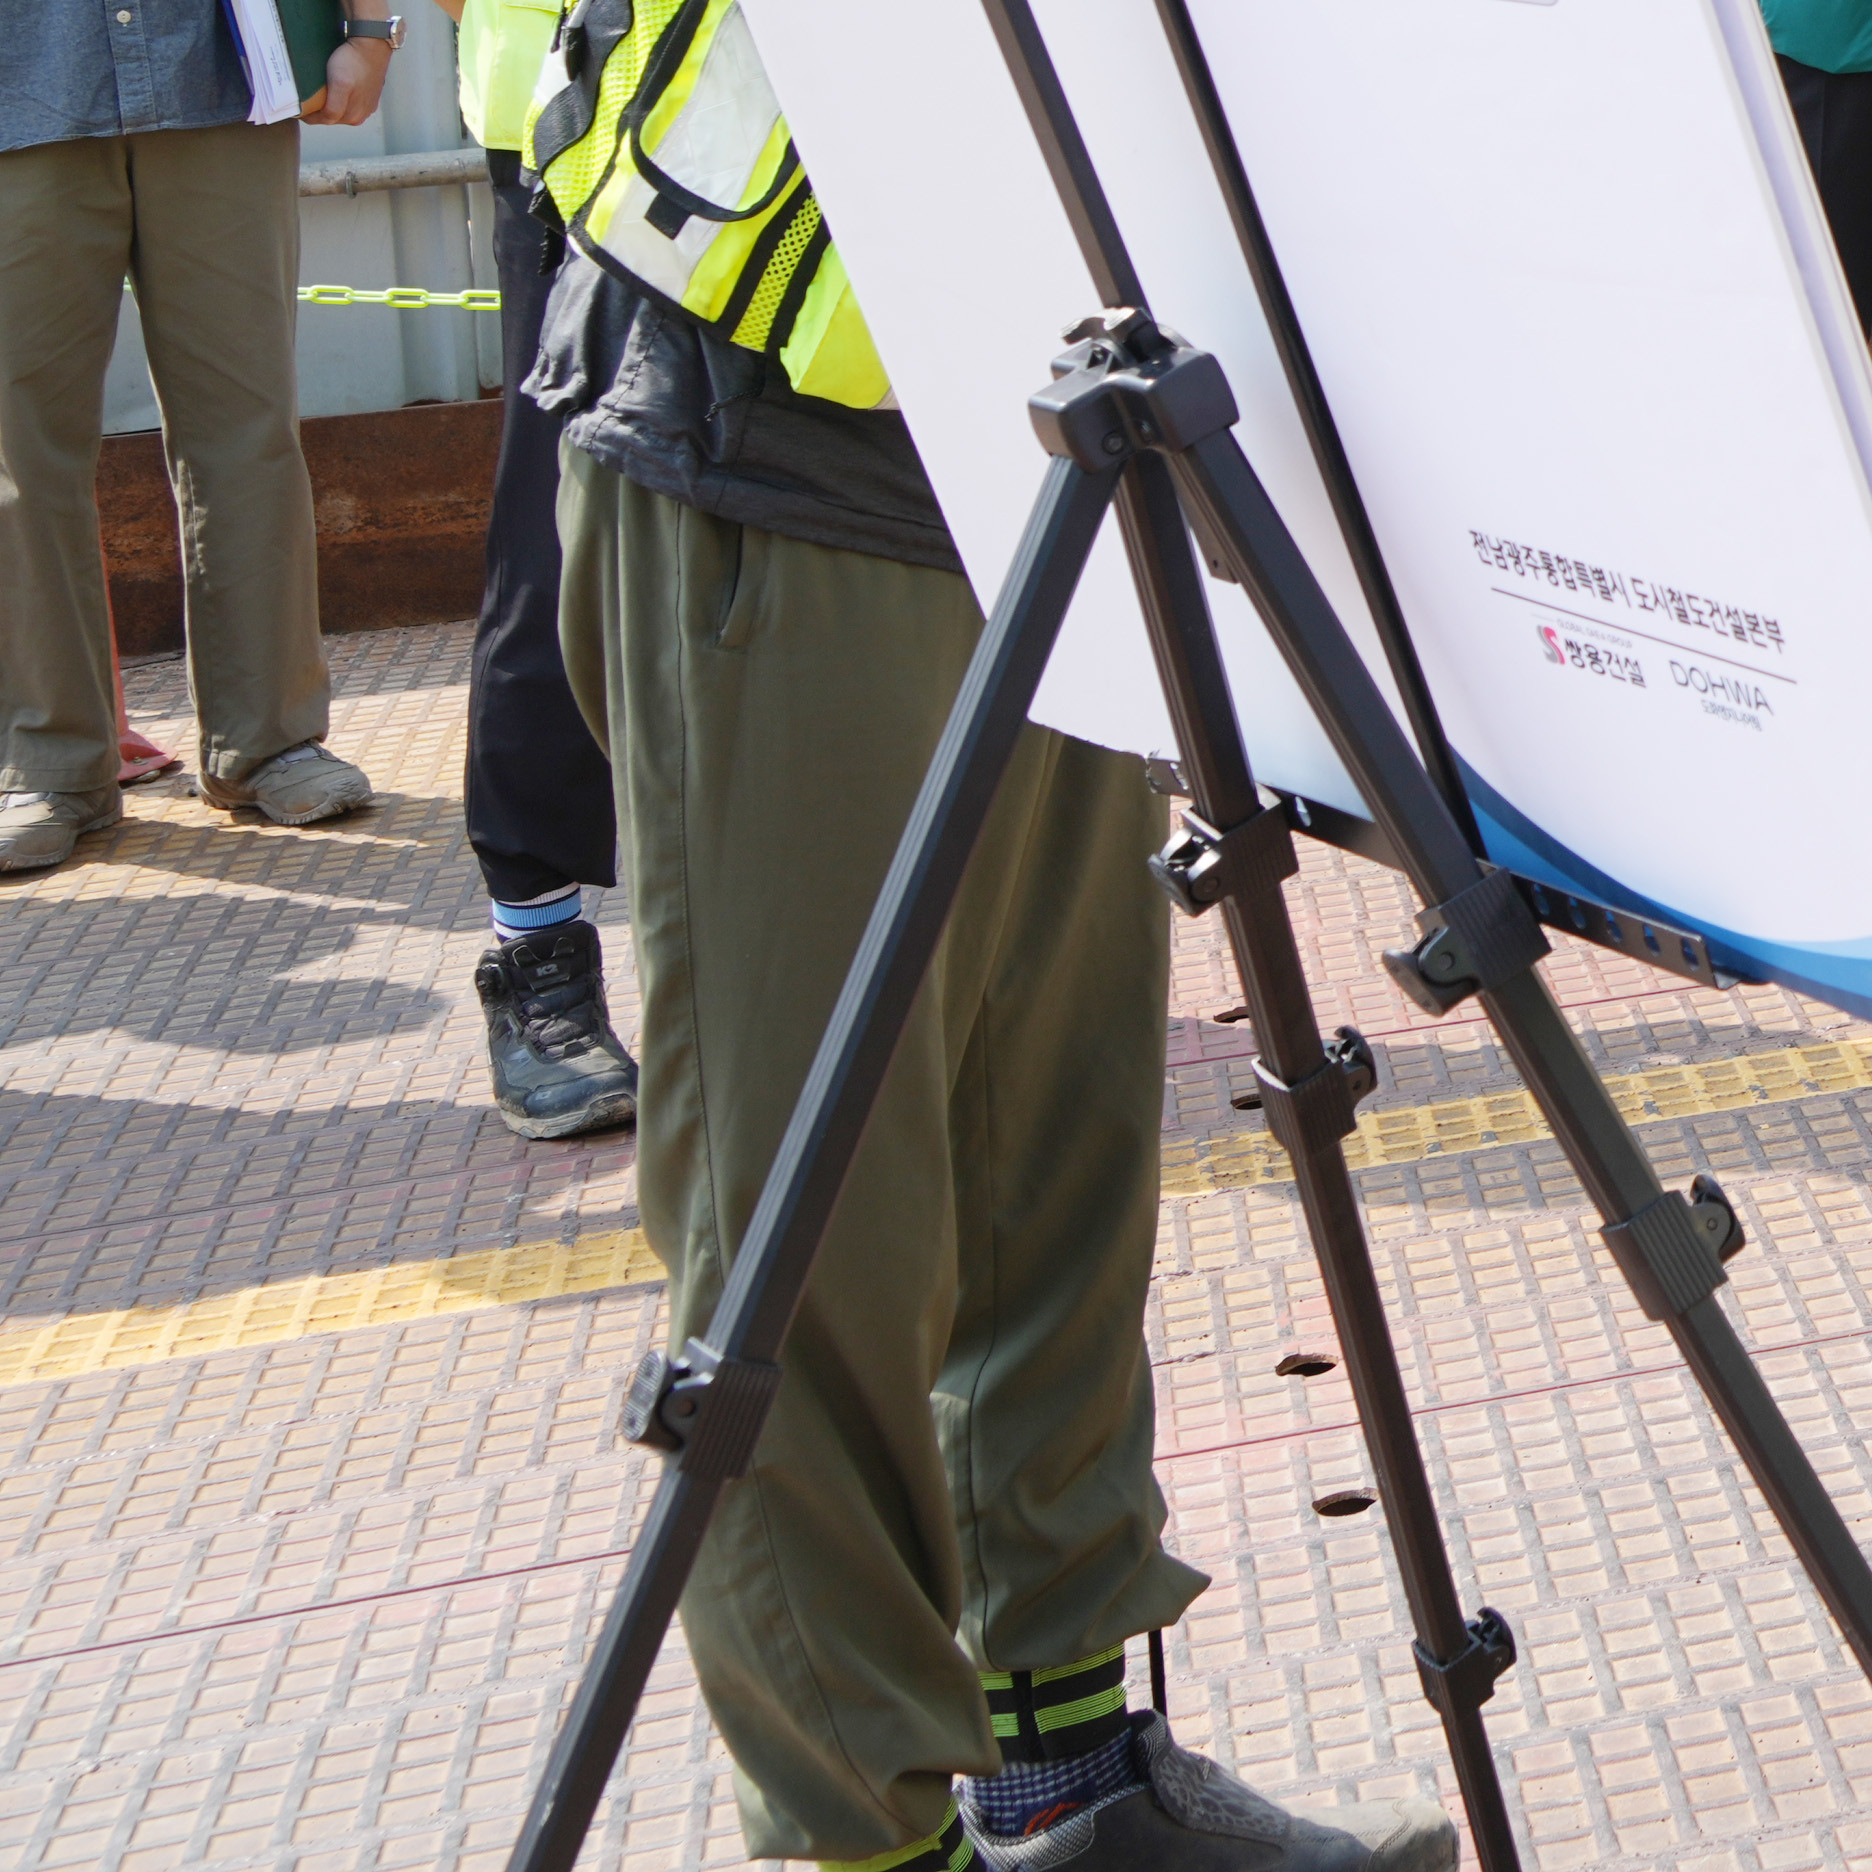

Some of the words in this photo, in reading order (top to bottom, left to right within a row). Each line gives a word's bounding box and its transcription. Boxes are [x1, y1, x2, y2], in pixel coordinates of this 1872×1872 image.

[1468, 529, 1633, 610] 전남광주통합특별시
[1631, 574, 1787, 655] 도시철도건설본부
[1564, 640, 1647, 687] 쌍용건설
[1668, 657, 1775, 715] DOHWA
